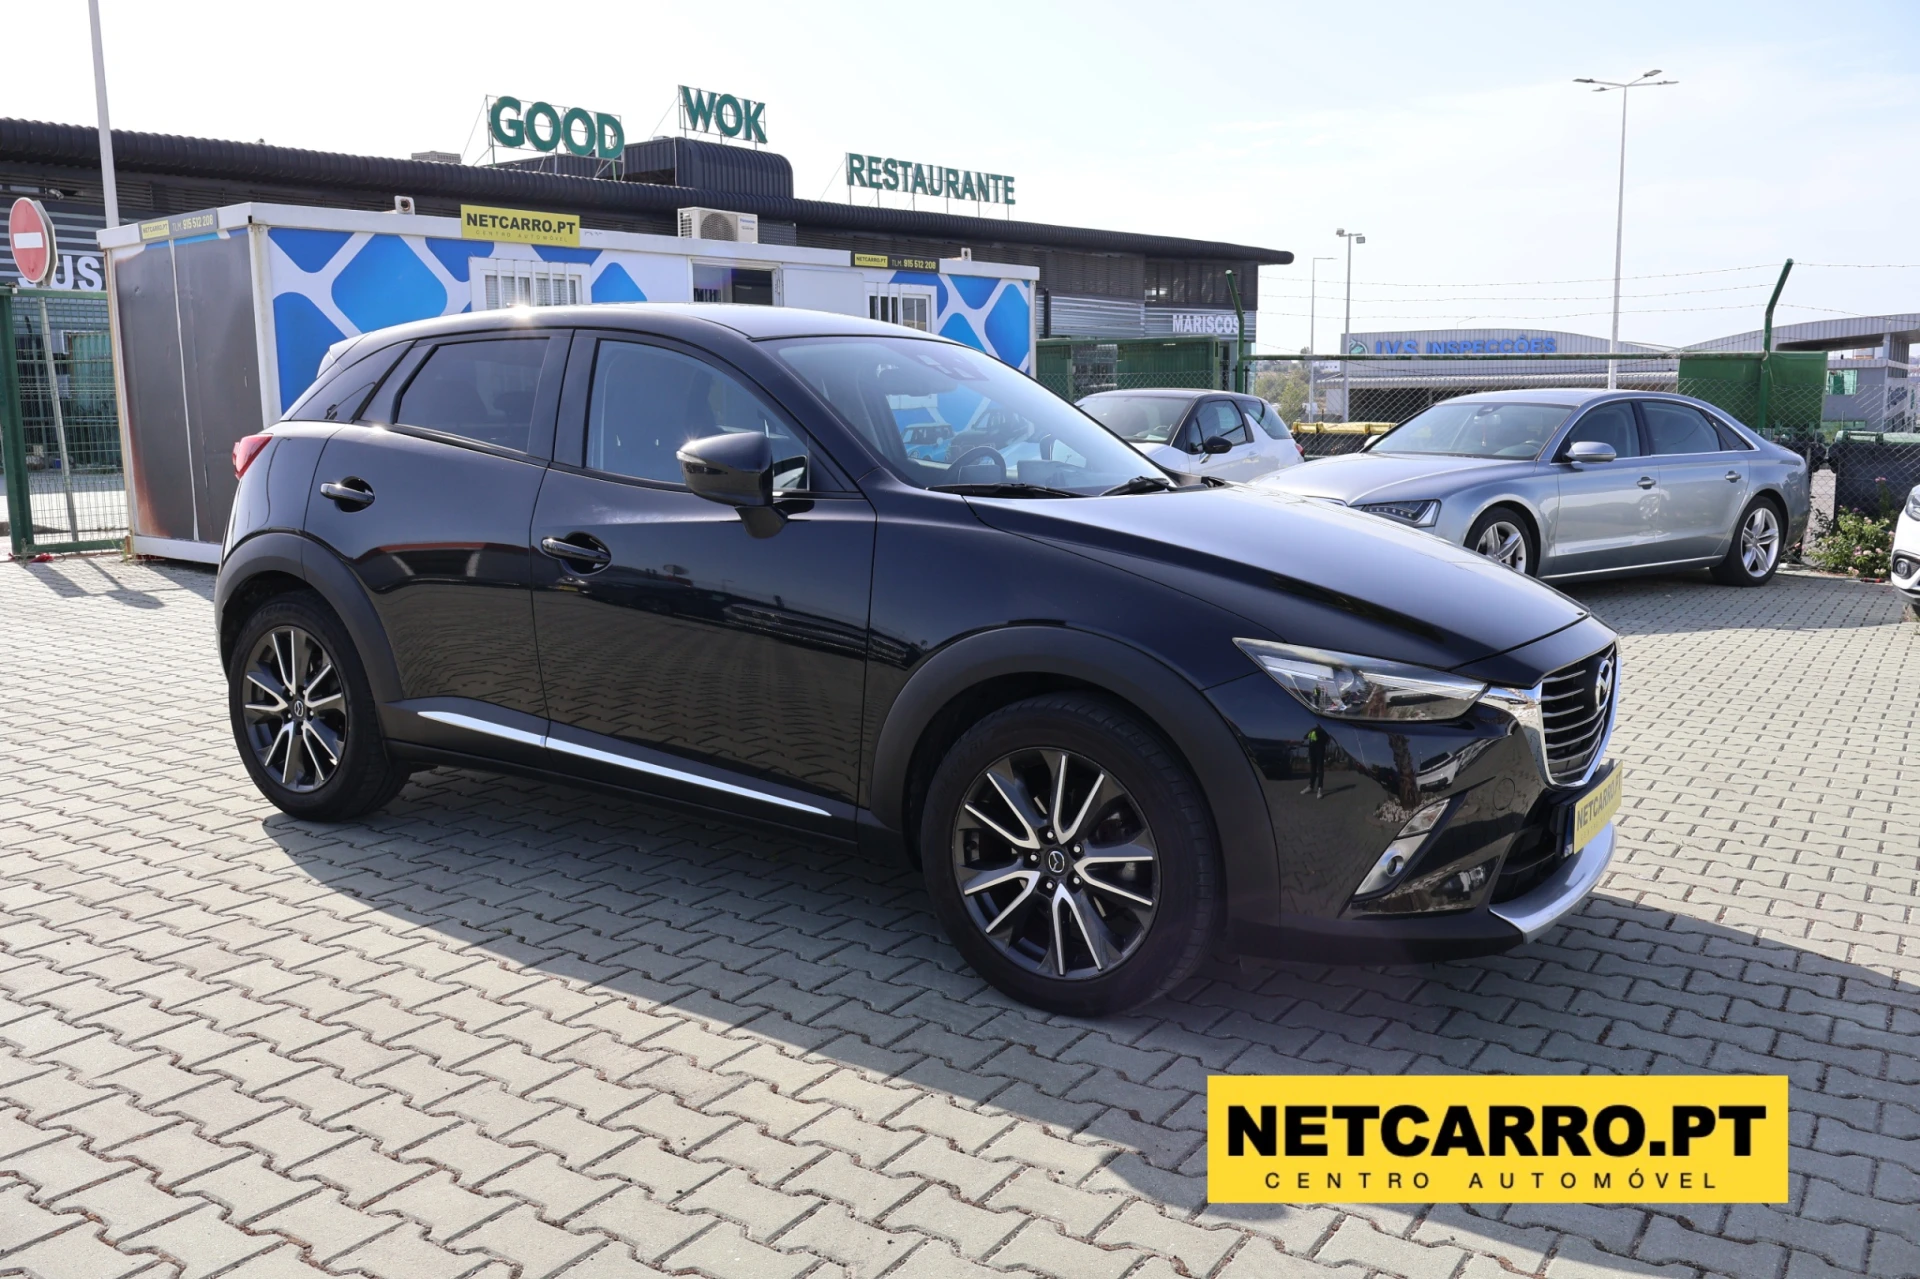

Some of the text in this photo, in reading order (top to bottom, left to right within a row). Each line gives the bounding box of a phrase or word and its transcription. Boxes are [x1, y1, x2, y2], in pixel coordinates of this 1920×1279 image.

[489, 86, 768, 160] GOOD WOK
[847, 153, 1016, 205] RESTAURANTE
[466, 213, 576, 234] NETCARRO.PT
[475, 229, 511, 238] CENTRO
[18, 255, 102, 290] US
[903, 258, 913, 268] 915
[1172, 314, 1239, 334] MARISCOS
